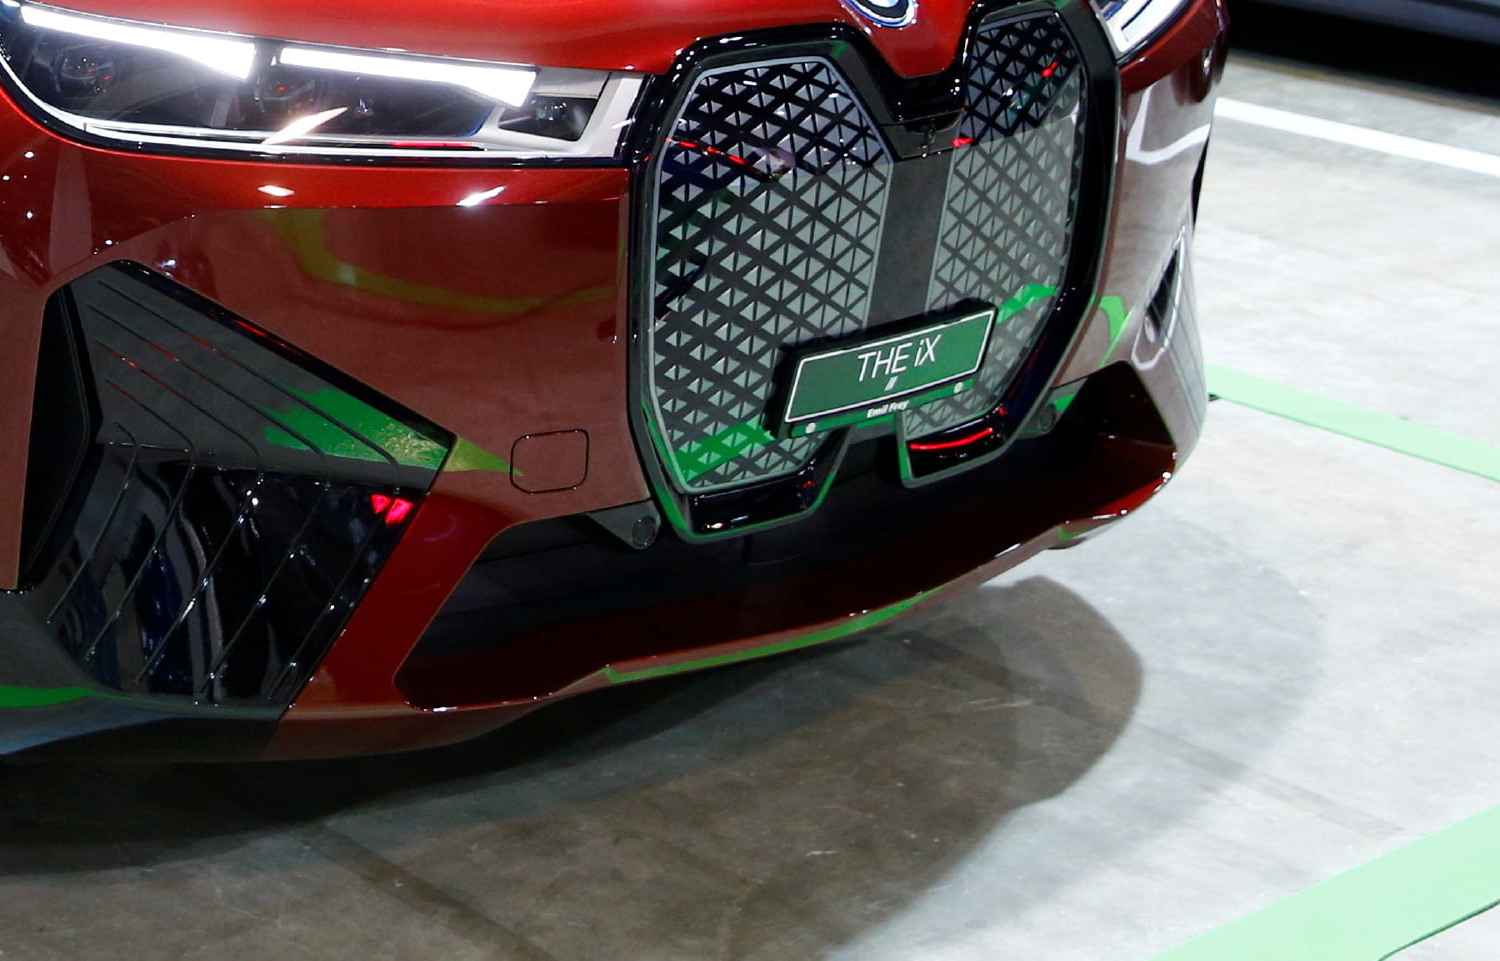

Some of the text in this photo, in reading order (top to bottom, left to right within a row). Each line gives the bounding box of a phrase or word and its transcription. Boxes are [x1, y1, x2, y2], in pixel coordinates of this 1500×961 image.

[857, 333, 942, 382] THE iX
[866, 399, 910, 419] Emil Frey
